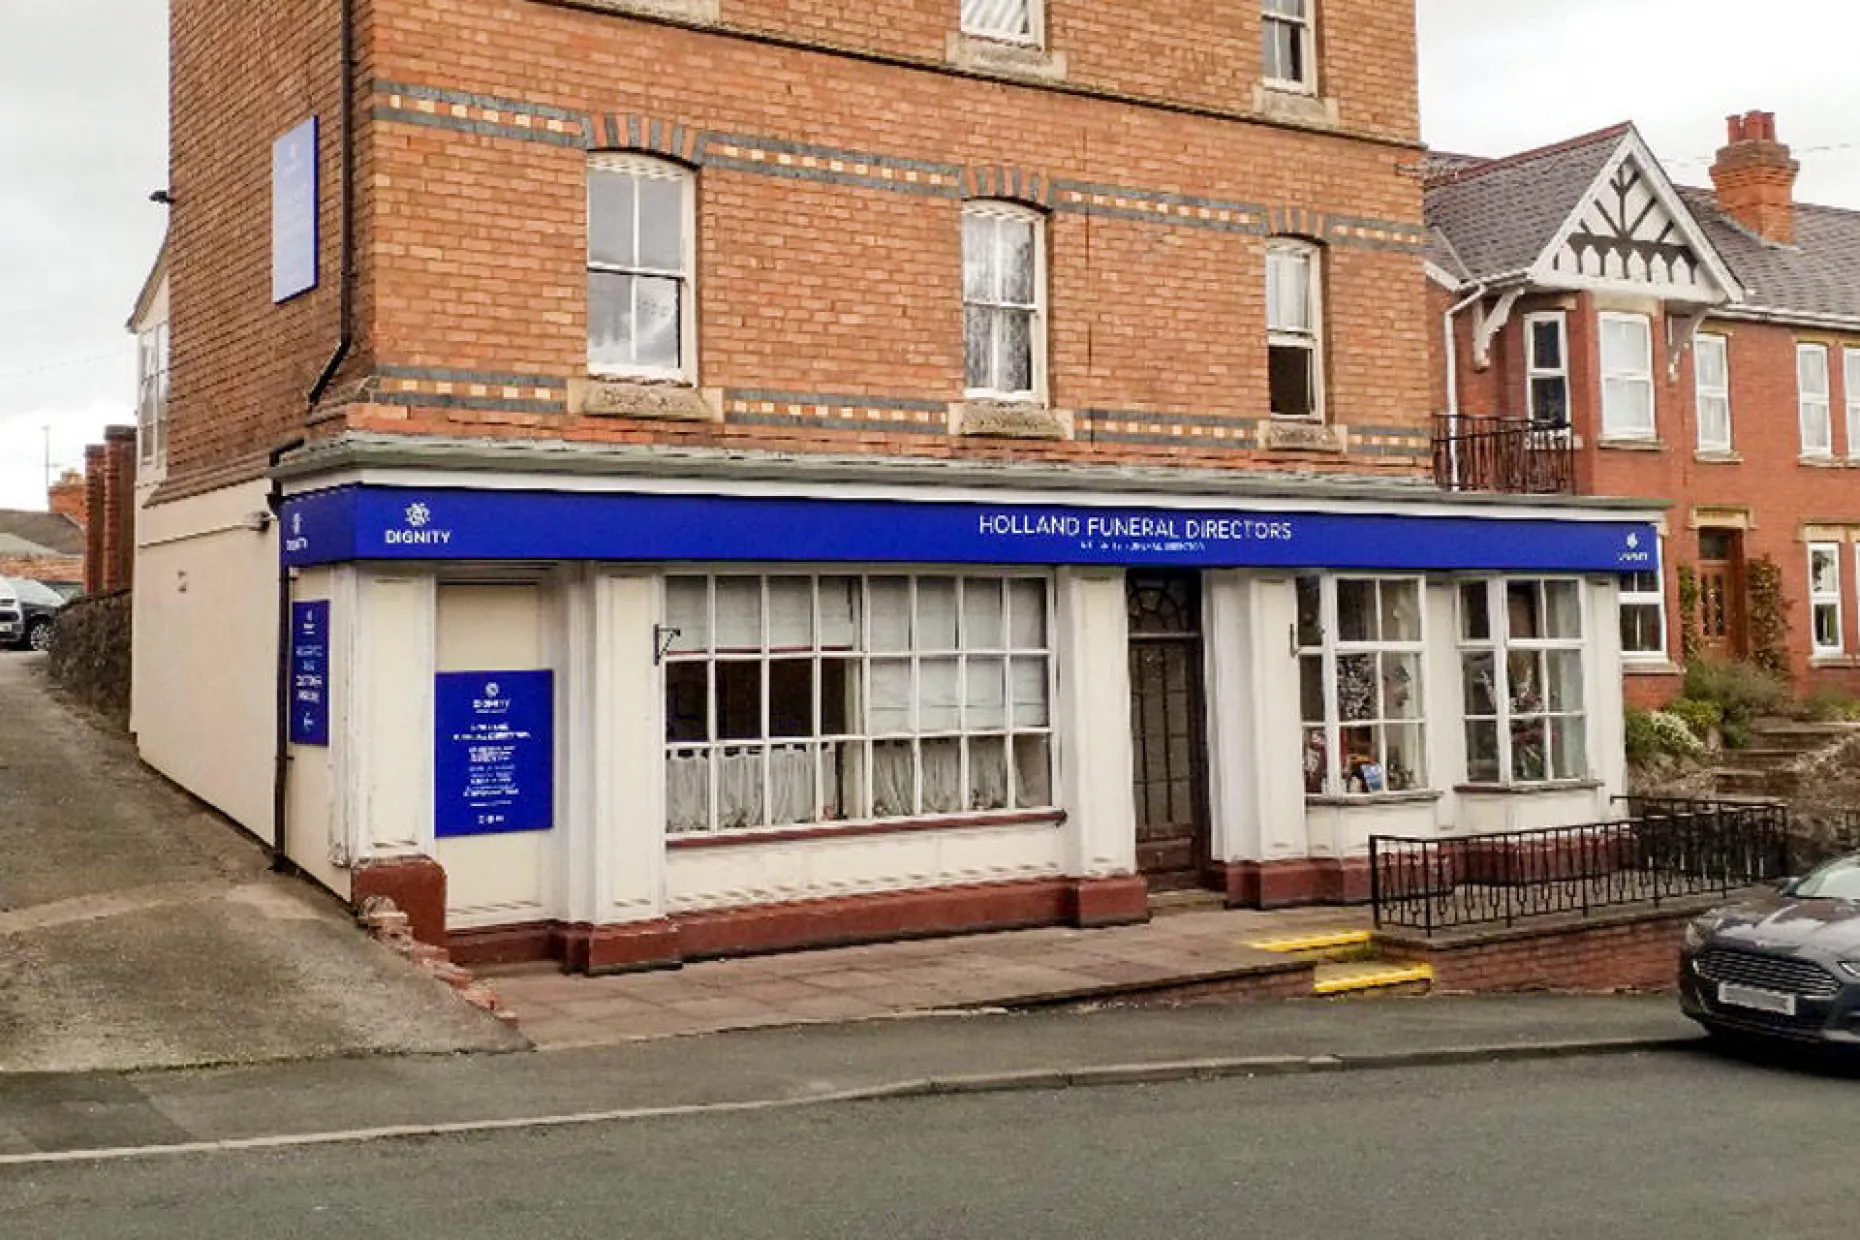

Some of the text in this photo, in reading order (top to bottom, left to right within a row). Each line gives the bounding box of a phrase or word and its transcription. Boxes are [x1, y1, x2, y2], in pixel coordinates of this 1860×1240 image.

[384, 529, 451, 544] DIGNITY
[979, 514, 1292, 540] HOLLAND FUNERAL DIRECTORS
